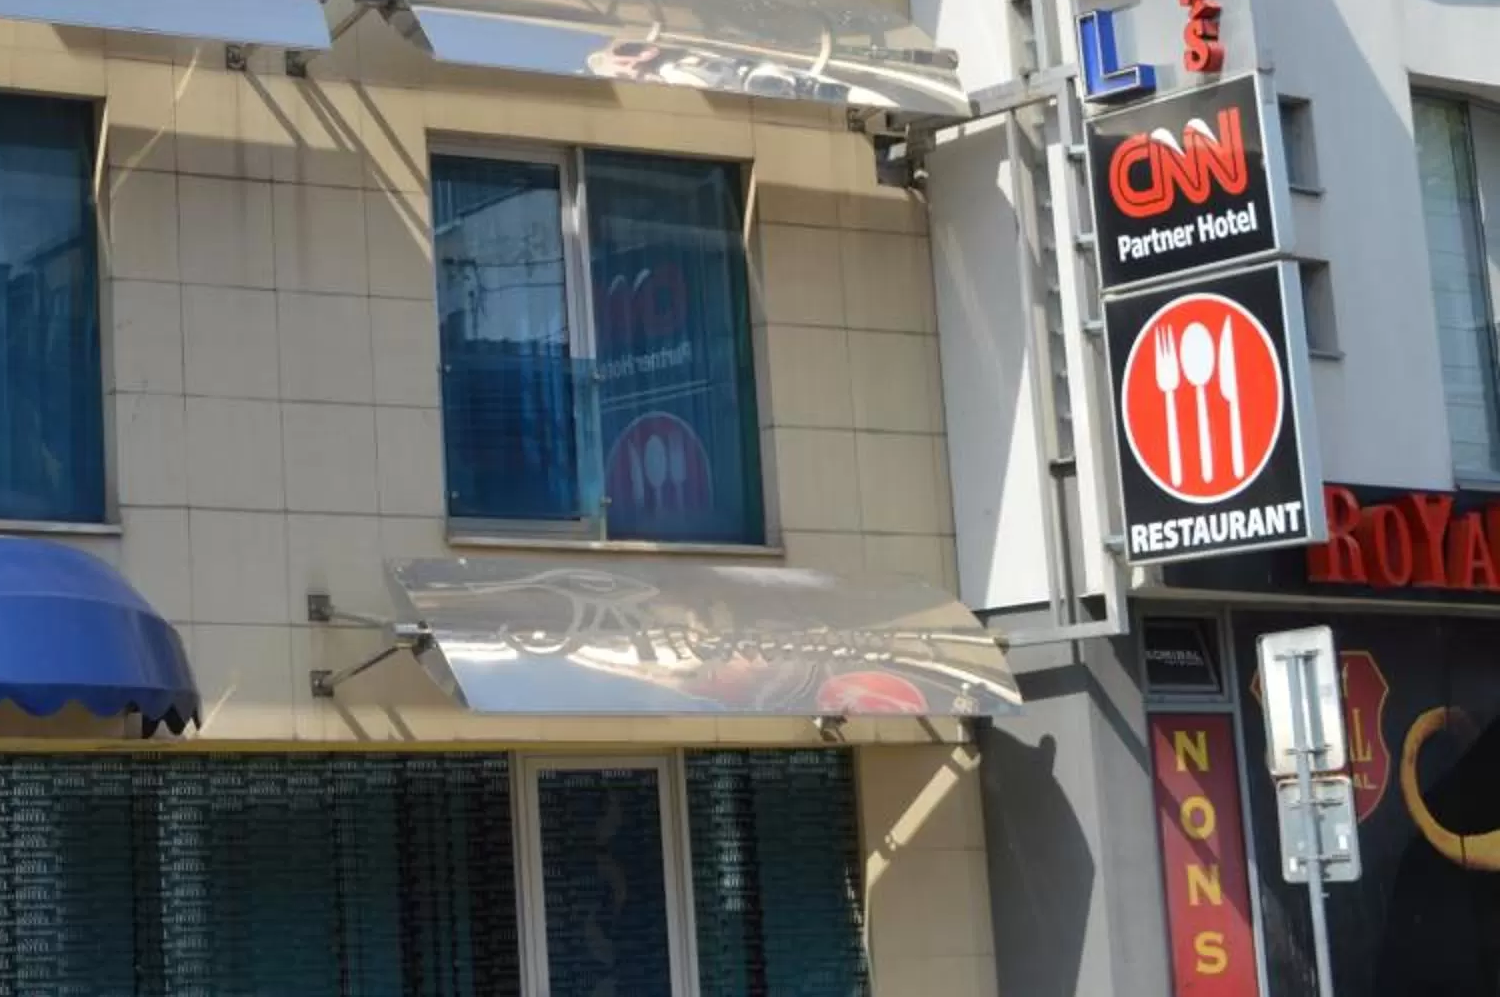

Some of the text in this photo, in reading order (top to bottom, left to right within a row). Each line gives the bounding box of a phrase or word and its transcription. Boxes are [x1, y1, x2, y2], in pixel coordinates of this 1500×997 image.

[1109, 106, 1247, 218] CNN
[1117, 201, 1258, 262] Partner Hotel
[1130, 501, 1302, 553] RESTAURANT
[1312, 484, 1500, 593] ROYA
